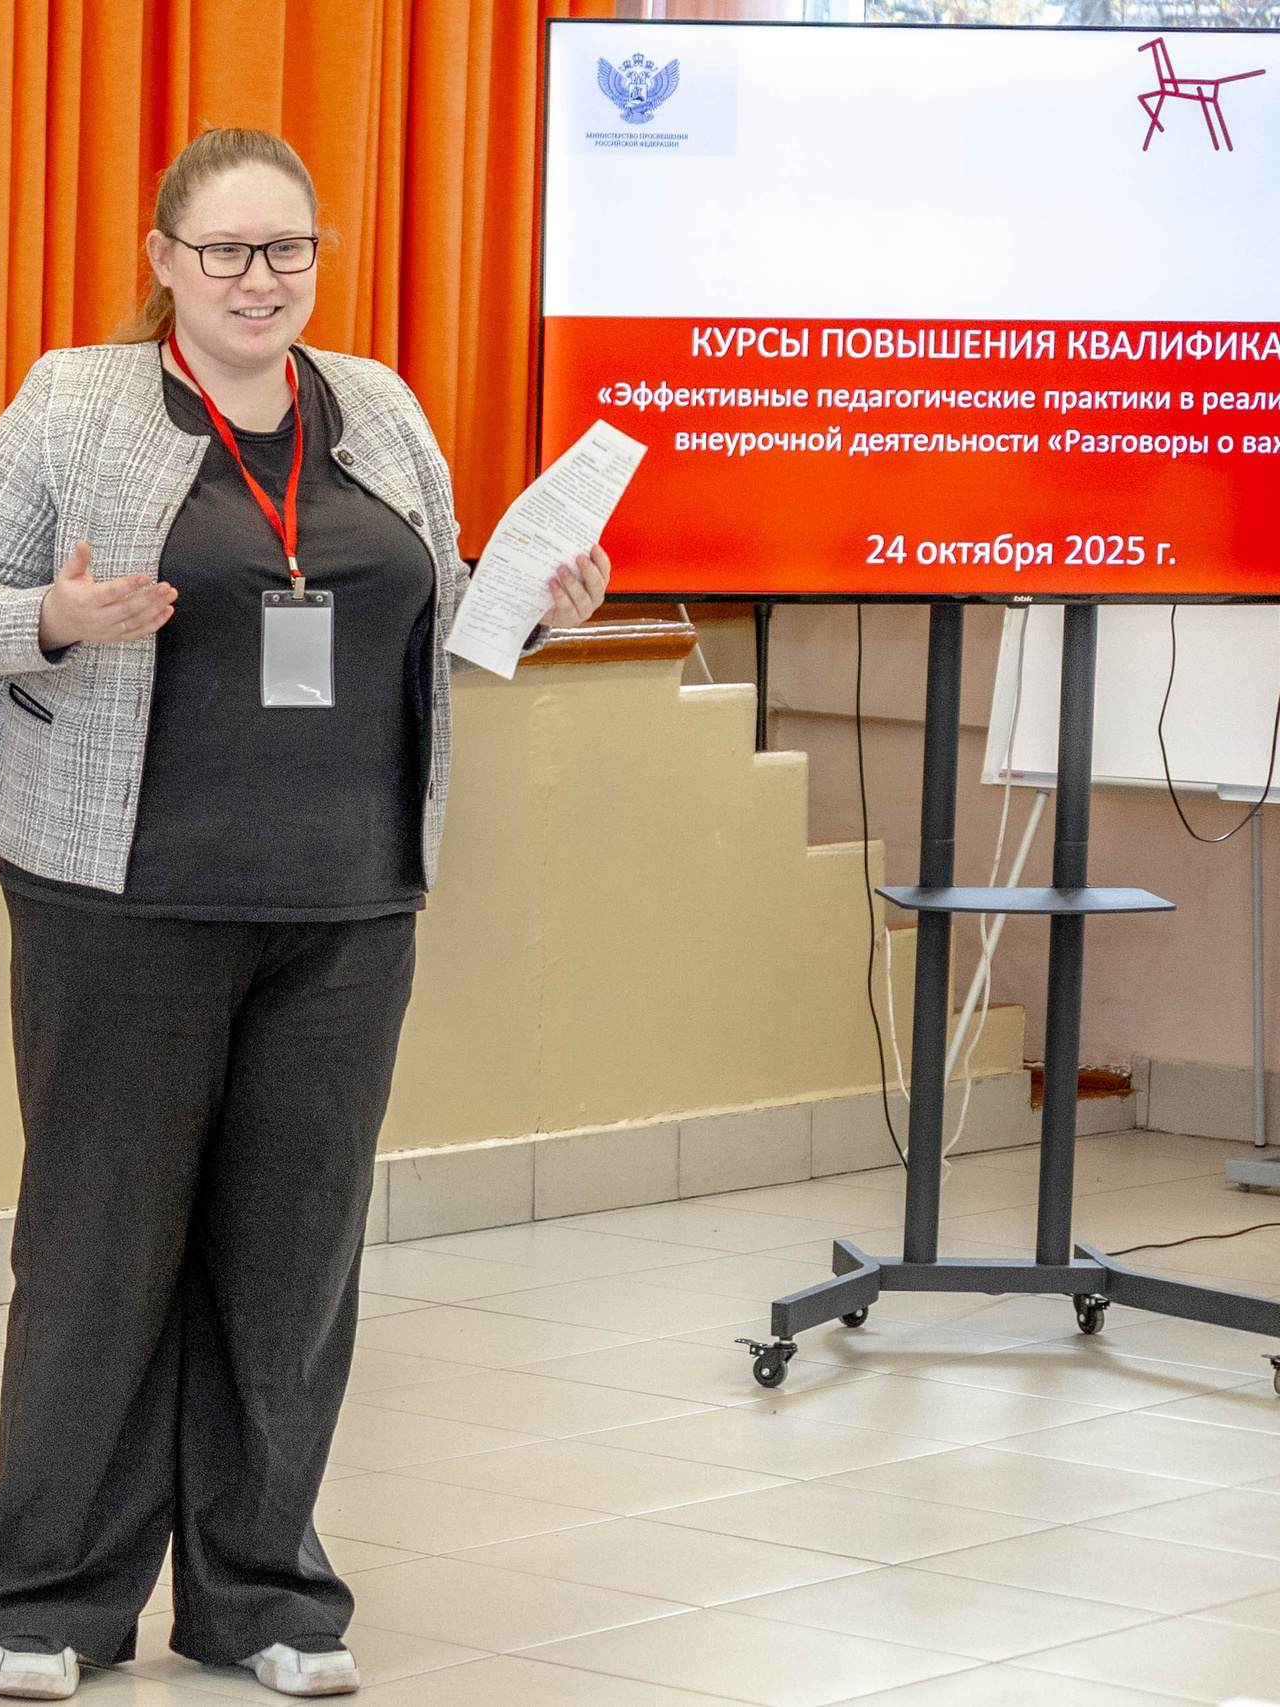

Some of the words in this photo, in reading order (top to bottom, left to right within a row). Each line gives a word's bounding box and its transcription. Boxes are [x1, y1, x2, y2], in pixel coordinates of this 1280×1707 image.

[585, 132, 639, 140] МИНИСТЕРСТВО
[692, 327, 810, 358] КУРСЫ
[820, 327, 1056, 360] ПОВЫШЕНИЯ
[1067, 330, 1280, 361] КВАЛИФИКА
[597, 381, 809, 412] «Эффективные
[817, 387, 1036, 413] педагогические
[1044, 390, 1171, 415] практики
[1180, 391, 1194, 410] в
[1203, 391, 1280, 415] реали
[675, 426, 843, 457] внеурочной
[849, 432, 1040, 457] деятельности
[1047, 429, 1209, 459] «Разговоры
[1217, 435, 1234, 453] о
[865, 534, 907, 564] 24
[916, 533, 1053, 572] октября
[1064, 535, 1145, 565] 2025
[1156, 542, 1176, 565] г.
